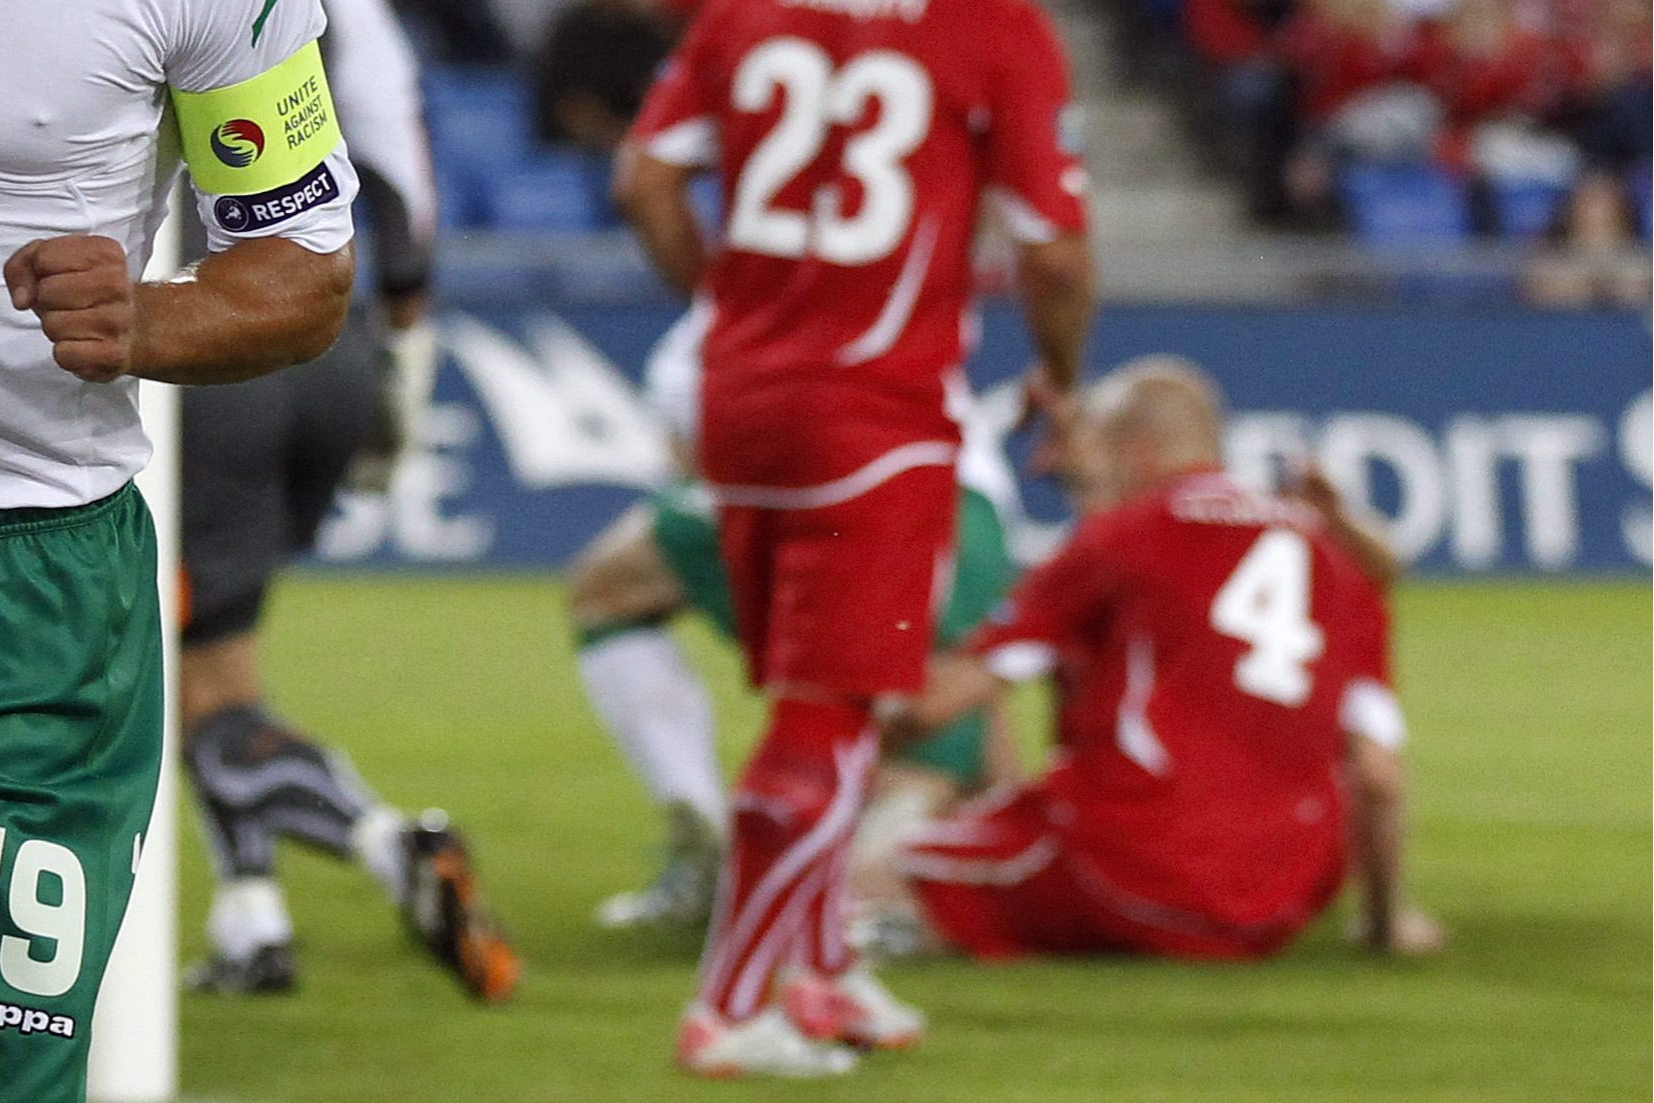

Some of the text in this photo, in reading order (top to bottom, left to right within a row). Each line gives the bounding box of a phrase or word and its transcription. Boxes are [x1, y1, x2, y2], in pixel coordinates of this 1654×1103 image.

[276, 75, 319, 116] UNITE
[283, 95, 323, 134] AGAINST
[286, 109, 328, 150] RACISM
[730, 35, 934, 267] 23
[251, 172, 331, 221] RESPECT
[1207, 526, 1327, 708] 4
